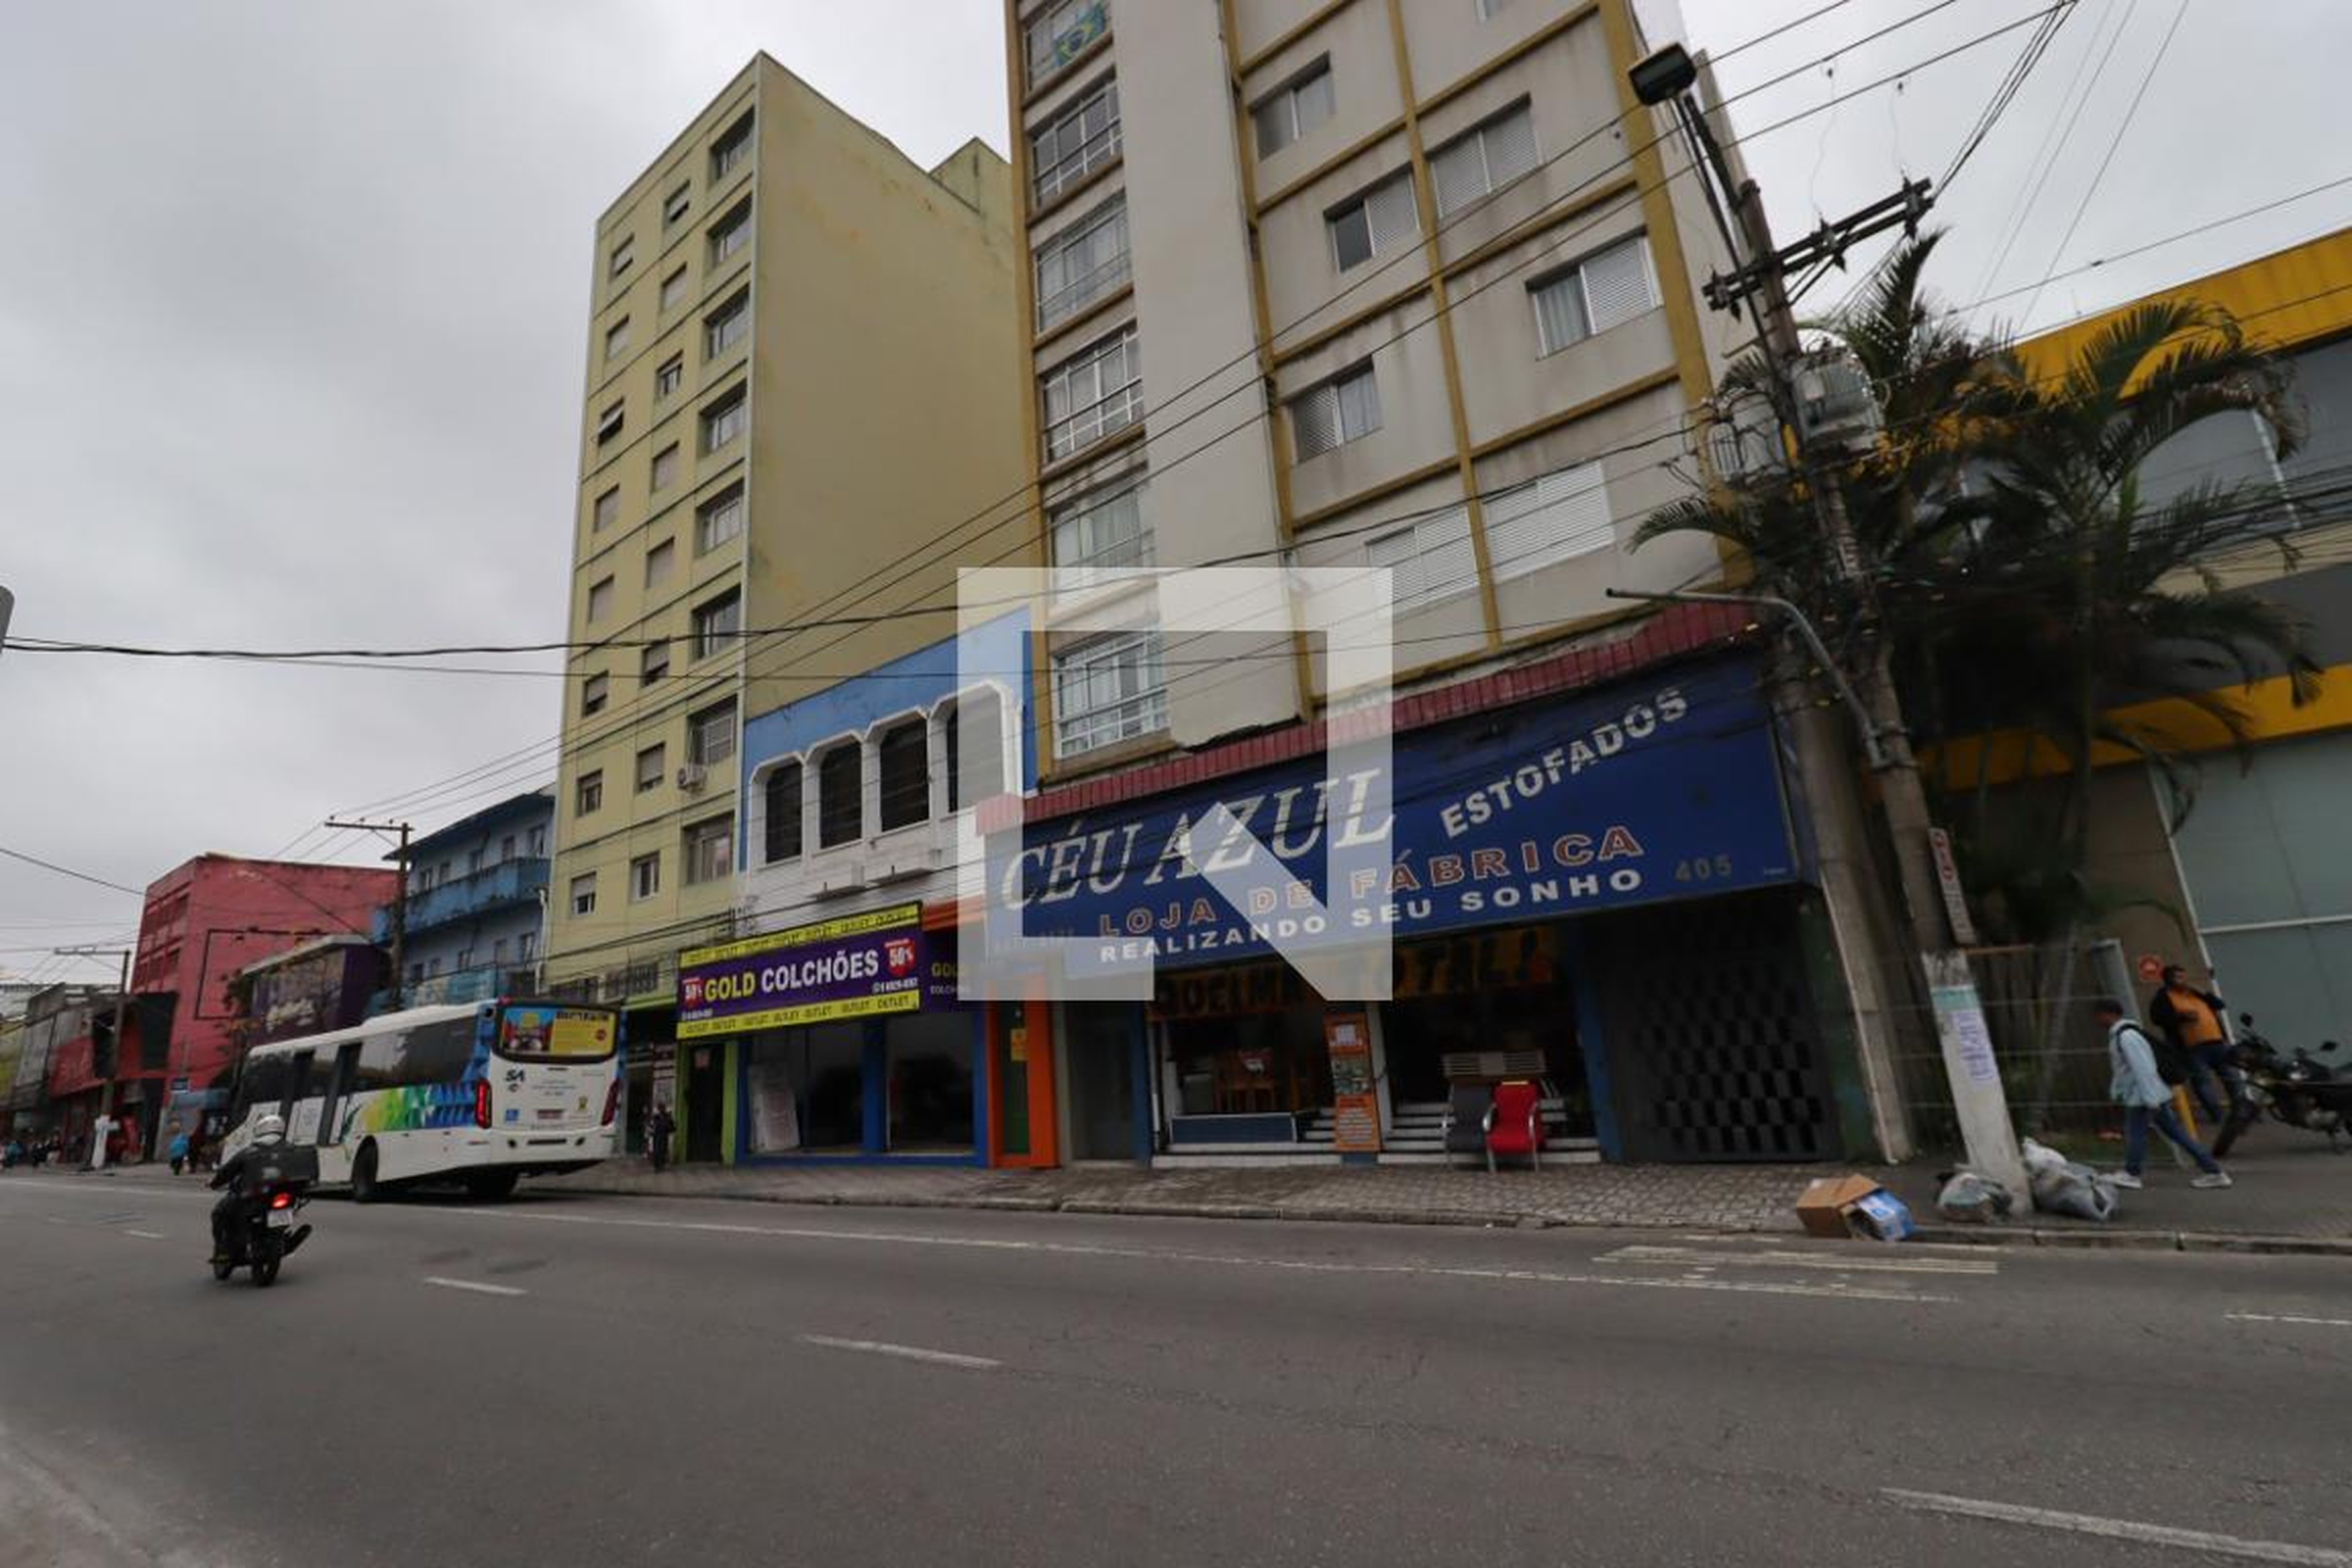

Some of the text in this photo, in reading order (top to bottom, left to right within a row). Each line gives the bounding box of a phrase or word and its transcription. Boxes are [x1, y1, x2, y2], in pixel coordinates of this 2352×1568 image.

[1440, 685, 1687, 839] ESTOFADOS
[1002, 767, 1395, 909] CÉU AZUL
[1100, 897, 1218, 937] LOJA
[1249, 880, 1312, 917] DE
[1349, 825, 1645, 899] FÁBRICA
[1673, 855, 1733, 883] 405
[1101, 915, 1327, 963] REALIZANDO
[1351, 899, 1431, 927] SEU
[1460, 869, 1642, 913] SONHO
[705, 971, 756, 1002] GOLD
[761, 949, 879, 993] COLCHÕES
